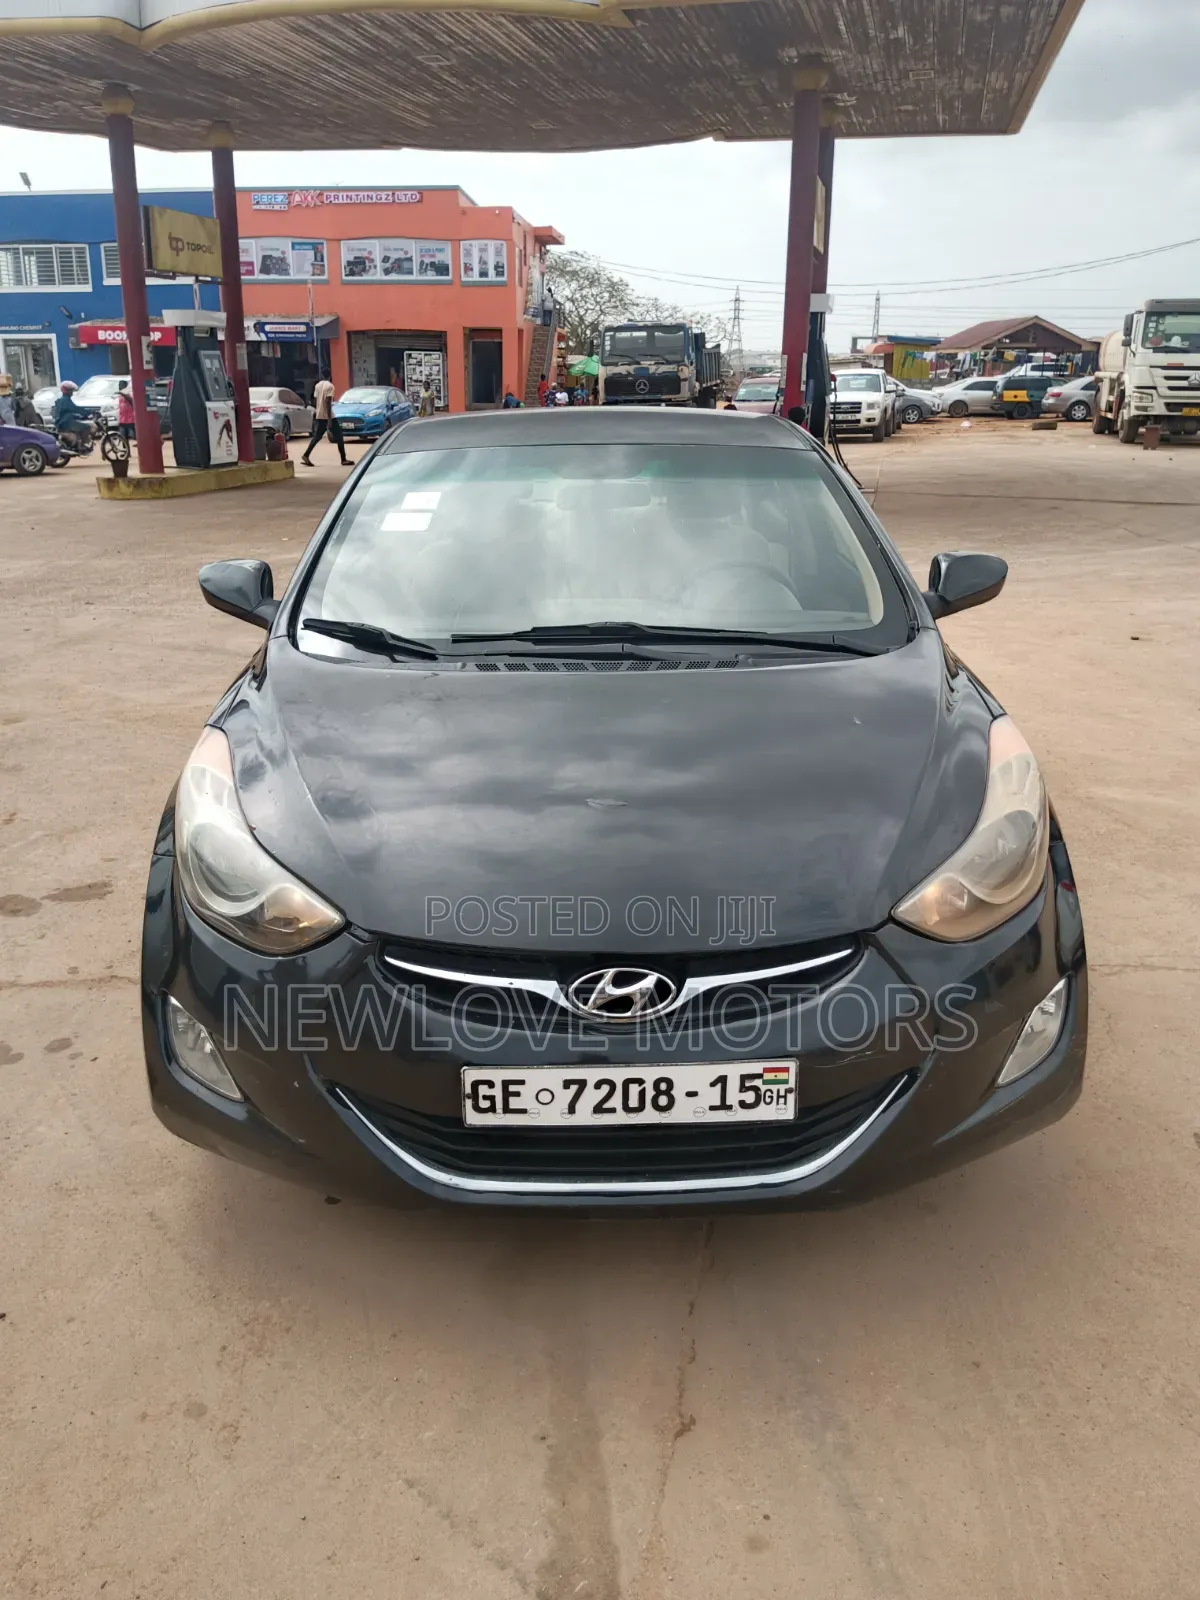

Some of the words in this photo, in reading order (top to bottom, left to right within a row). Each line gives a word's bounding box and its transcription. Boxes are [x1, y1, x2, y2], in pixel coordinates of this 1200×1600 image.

[253, 193, 287, 204] PEREZ
[291, 190, 321, 208] AKK
[325, 193, 392, 203] PRINTINGZ
[396, 192, 418, 202] LTD
[186, 242, 215, 254] TOPOIL
[470, 1079, 528, 1115] GE
[763, 1088, 788, 1106] GH
